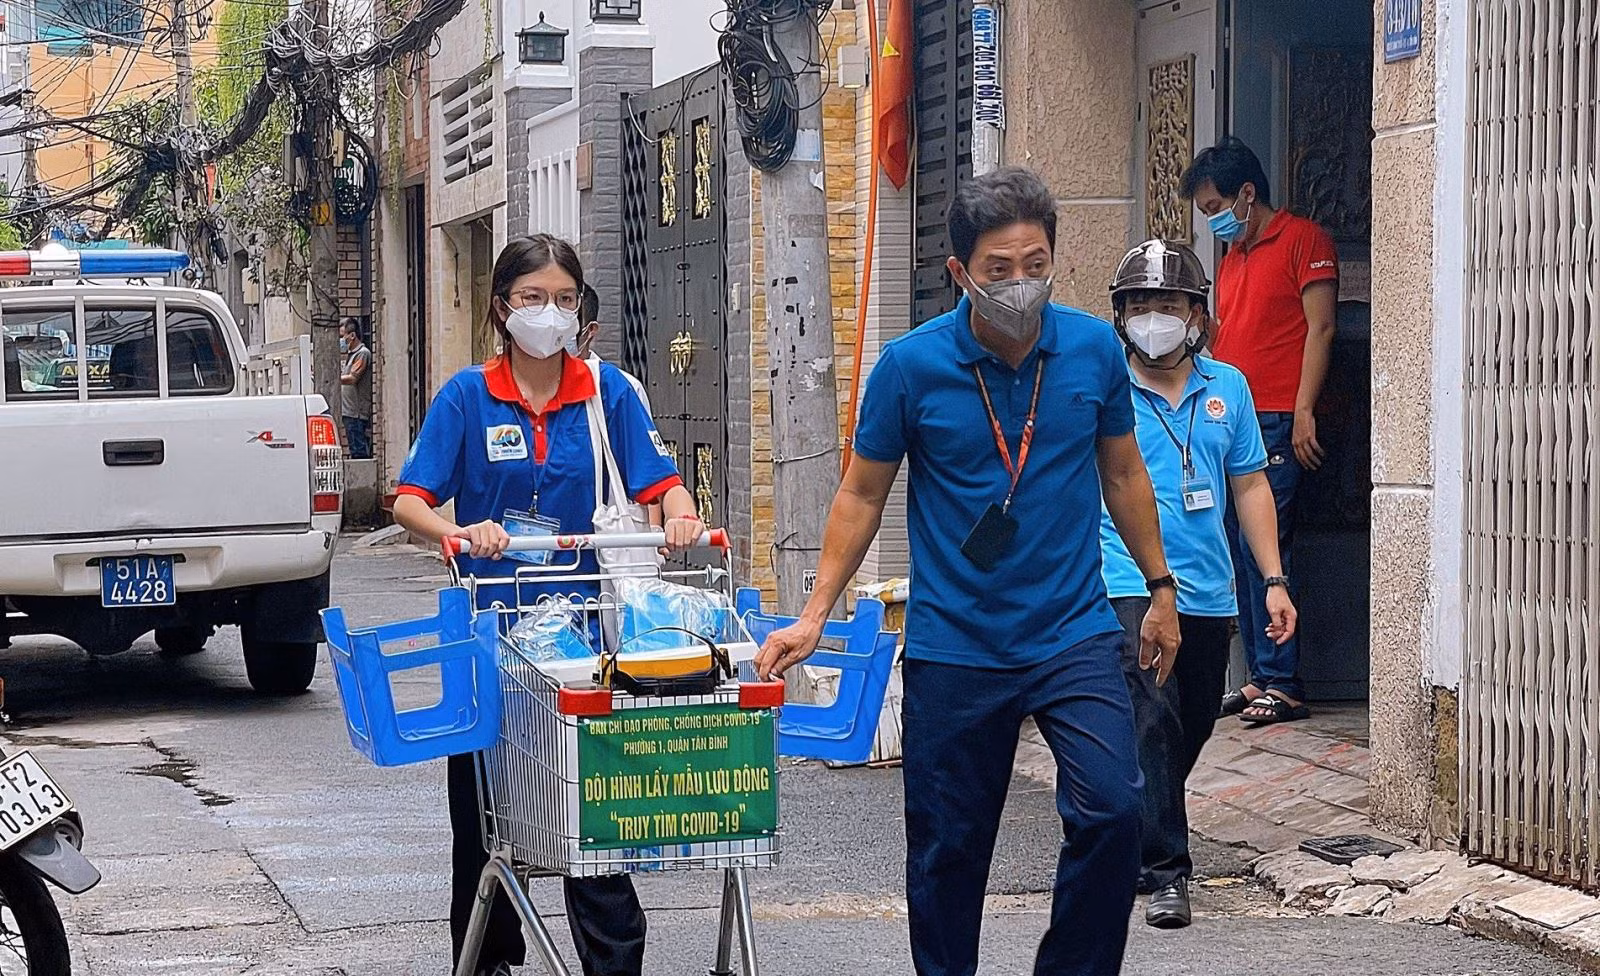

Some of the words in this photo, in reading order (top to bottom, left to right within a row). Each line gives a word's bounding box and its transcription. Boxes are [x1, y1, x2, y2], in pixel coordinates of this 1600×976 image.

[116, 558, 158, 580] 51A
[111, 580, 167, 604] 4428
[589, 721, 607, 735] BAN
[608, 715, 623, 734] CHỈ
[642, 714, 673, 733] PHÒNG,
[674, 712, 702, 730] CHỐNG
[703, 713, 722, 731] DỊCH
[723, 711, 760, 728] COVID-19
[624, 738, 657, 756] PHƯỜNG
[658, 740, 666, 755] 1,
[667, 736, 689, 754] QUẬN
[691, 734, 707, 751] TÂN
[708, 734, 728, 750] BÌNH
[0, 762, 37, 804] -F2
[584, 772, 607, 807] ĐỘI
[610, 771, 642, 800] HÌNH
[645, 766, 670, 798] LẤY
[673, 763, 703, 797] MẪU
[706, 767, 730, 795] LƯU
[733, 763, 769, 798] ĐỘNG
[653, 809, 677, 838] TÌM
